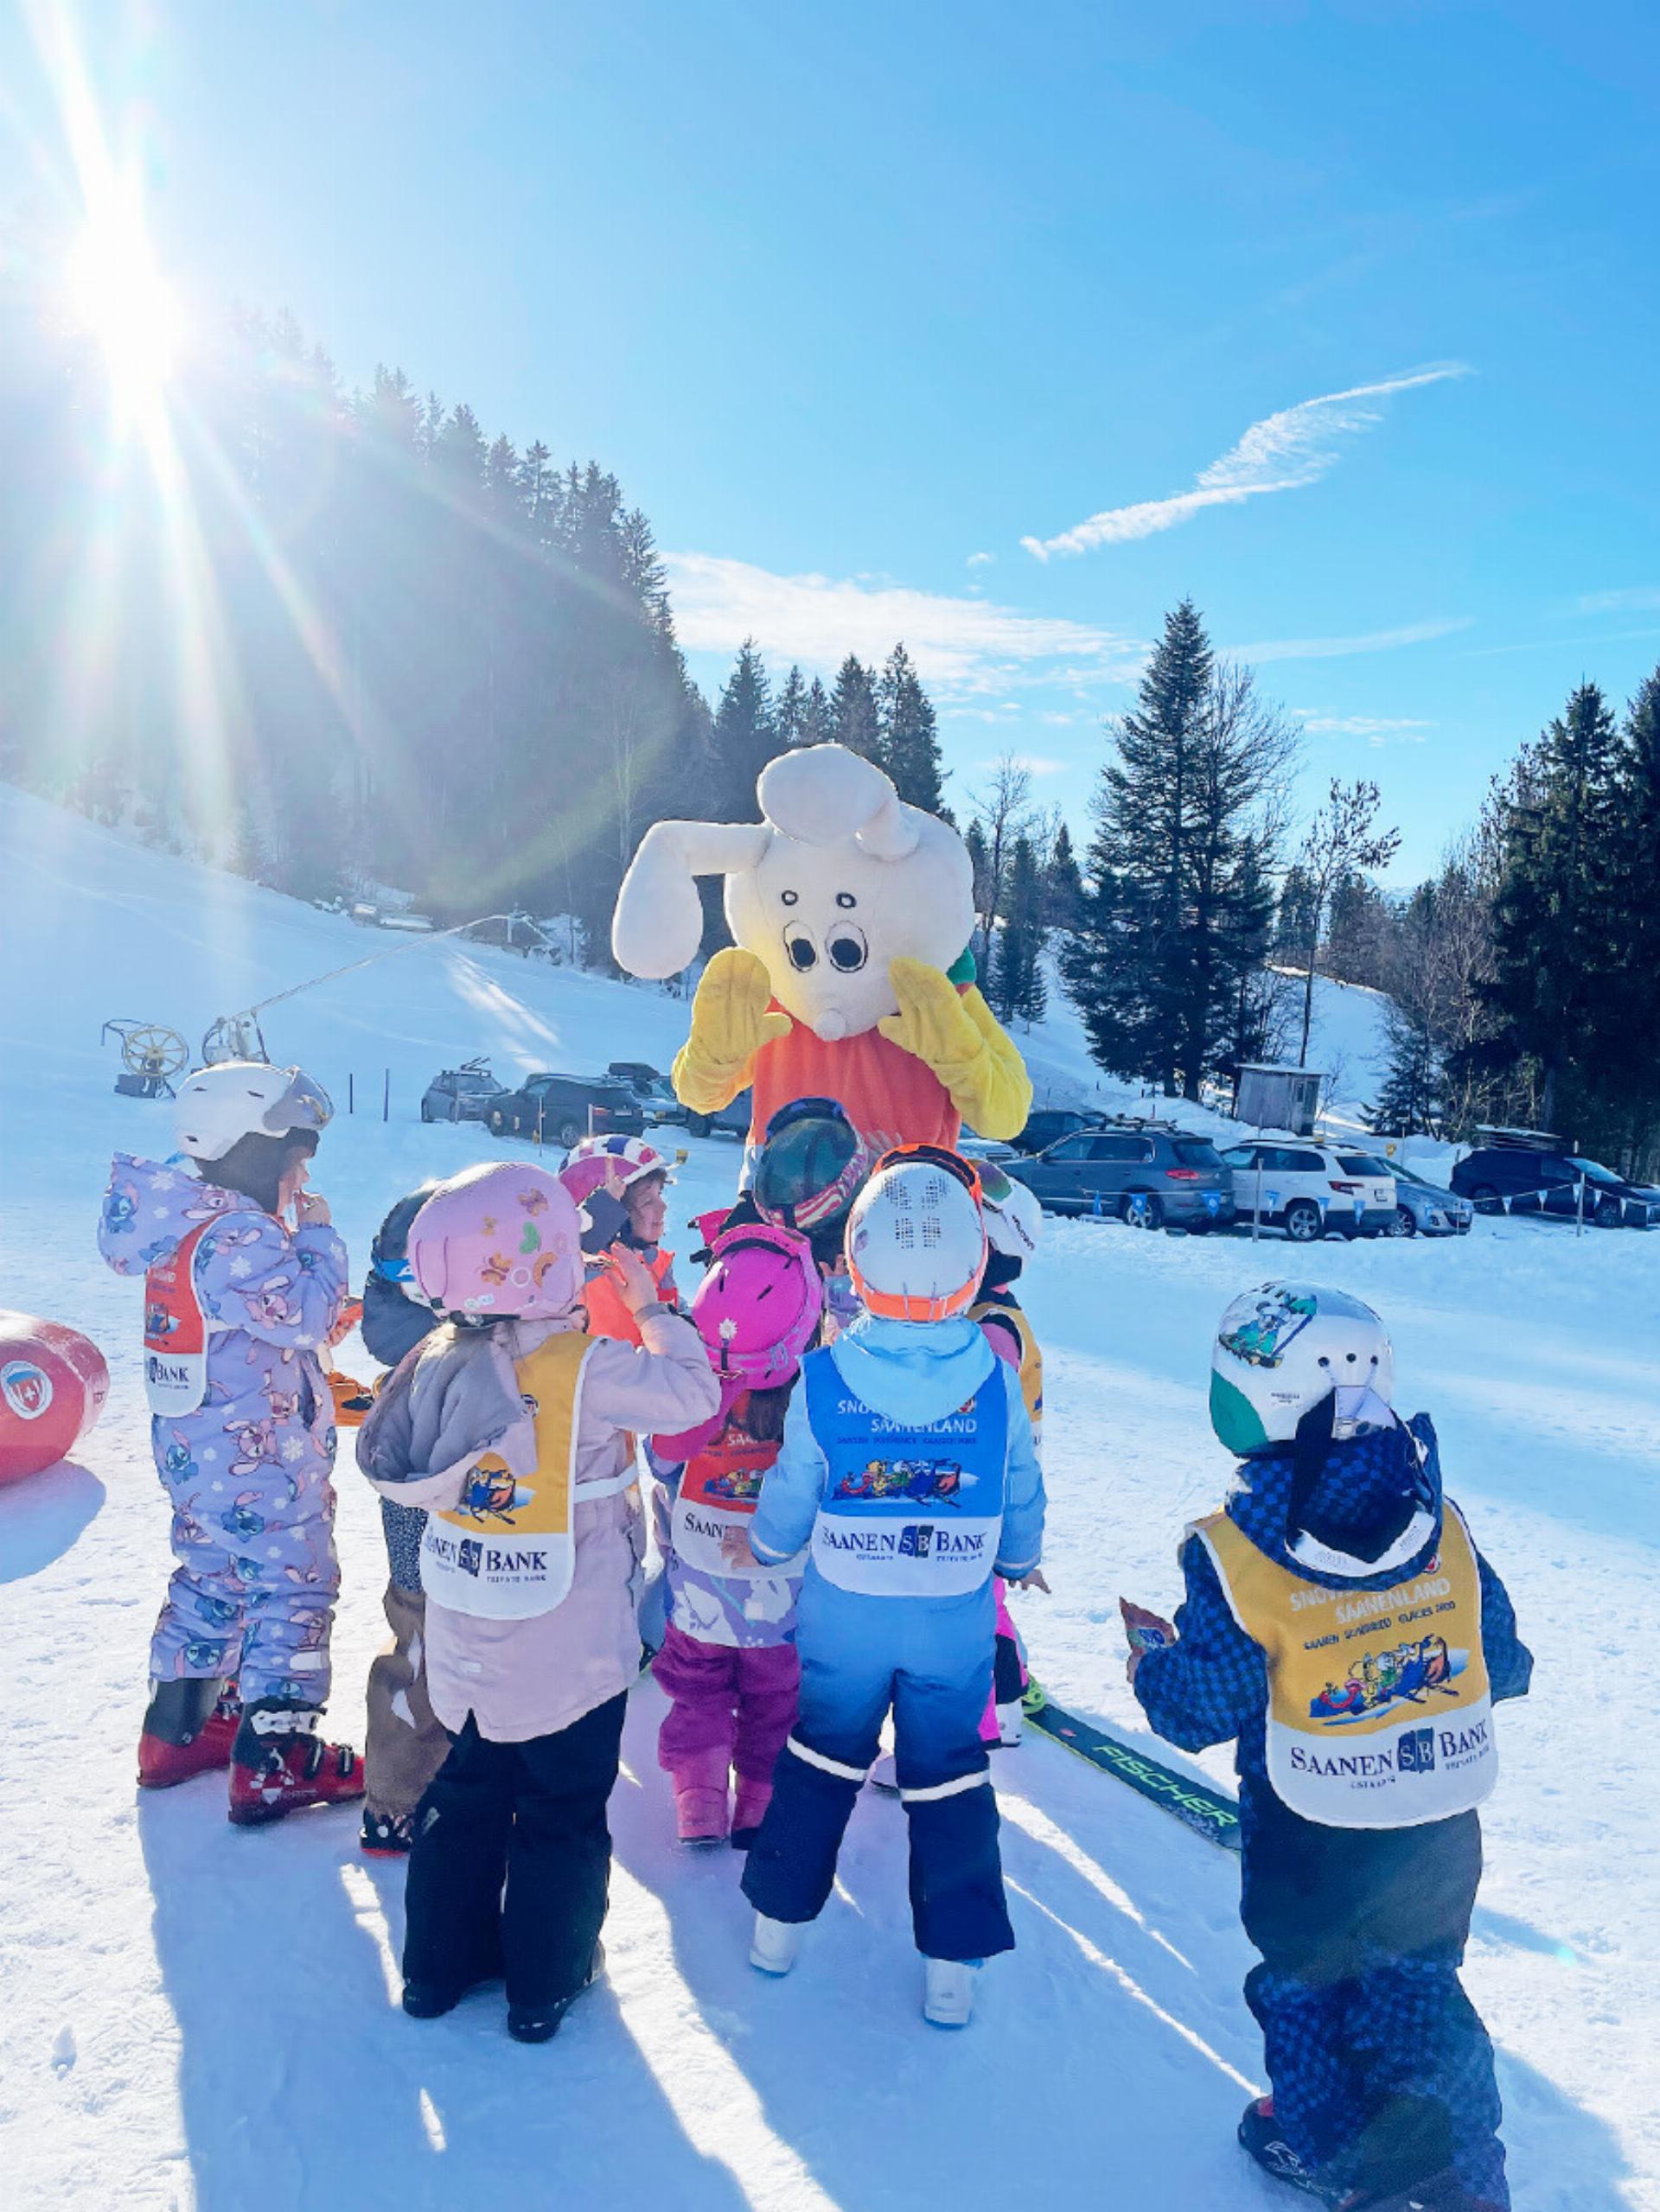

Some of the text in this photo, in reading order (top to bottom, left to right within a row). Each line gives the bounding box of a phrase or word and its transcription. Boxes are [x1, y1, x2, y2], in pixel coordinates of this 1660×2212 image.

[935, 1531, 987, 1552] BANK
[485, 1550, 548, 1571] BANK
[1336, 1578, 1451, 1624] SAANENLAND
[1291, 1746, 1393, 1776] SAANEN
[1093, 1744, 1239, 1827] FISCHER
